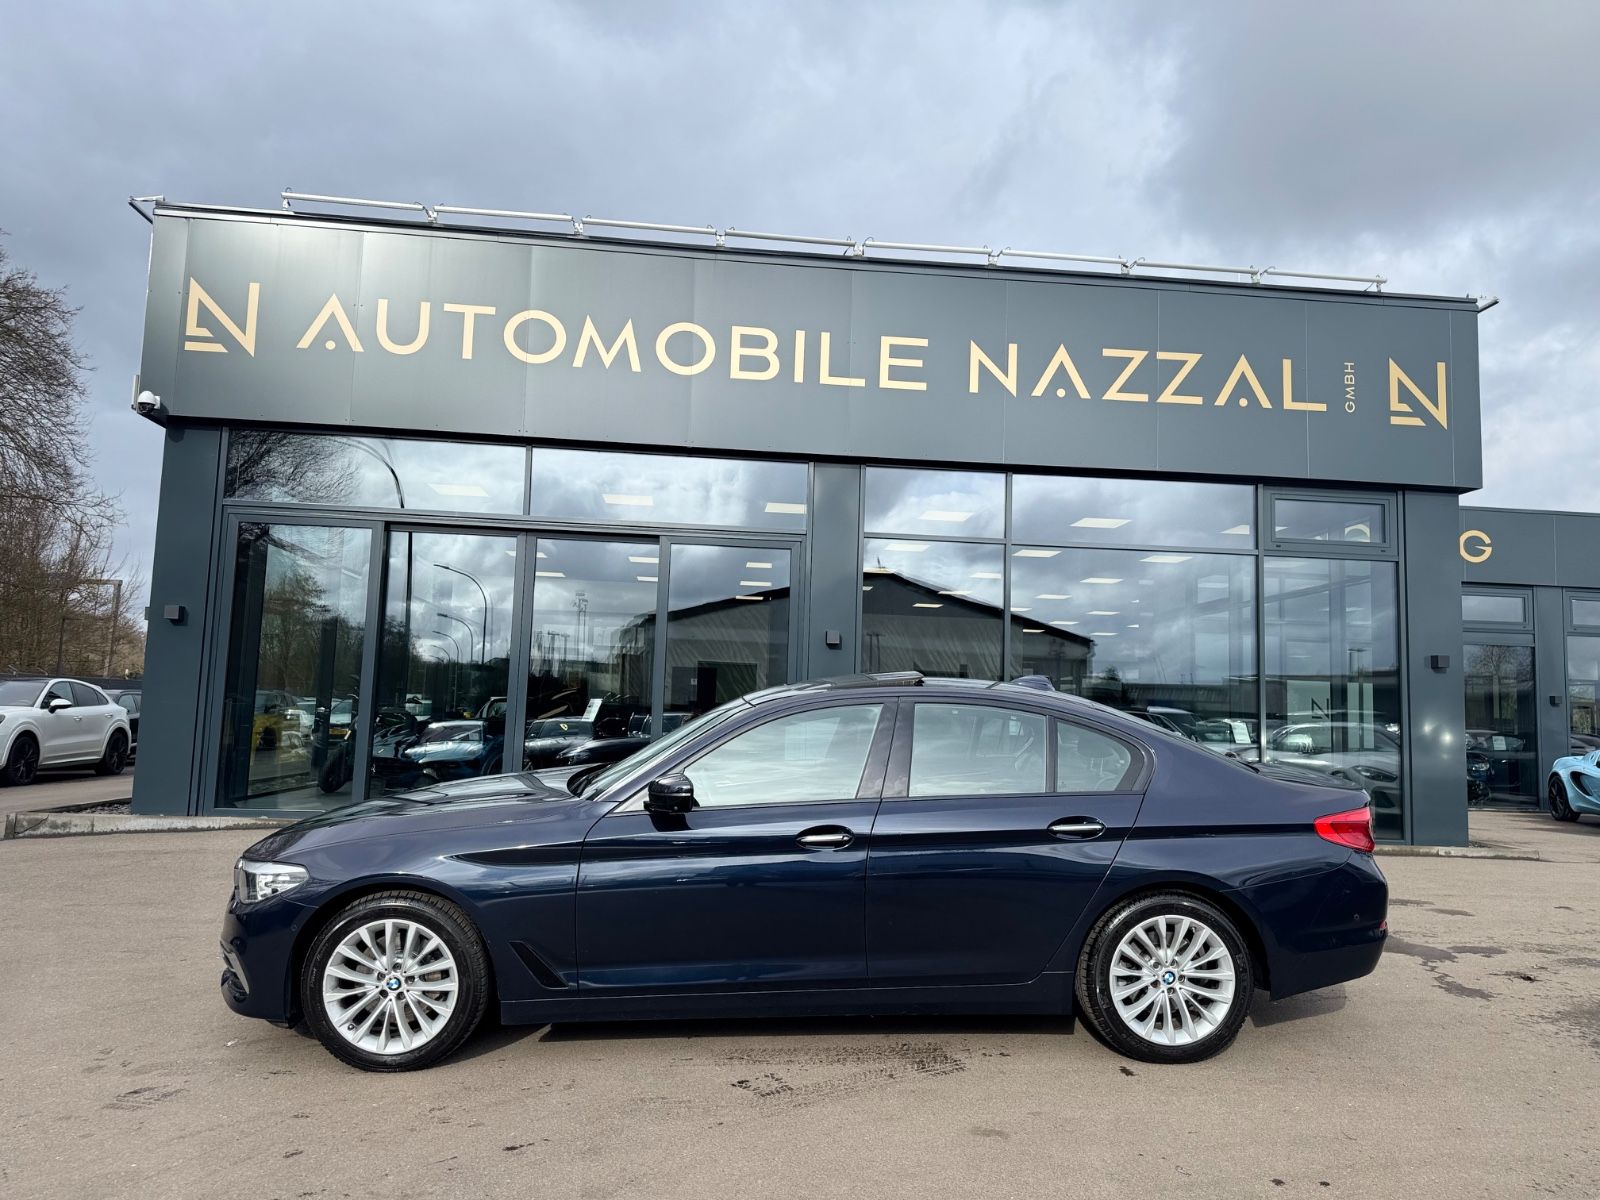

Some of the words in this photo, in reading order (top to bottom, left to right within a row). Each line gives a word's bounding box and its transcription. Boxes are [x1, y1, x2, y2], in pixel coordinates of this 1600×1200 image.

[297, 294, 929, 392] AUTOMOBILE
[969, 341, 1327, 414] NAZZAL
[1344, 361, 1356, 413] GMBH
